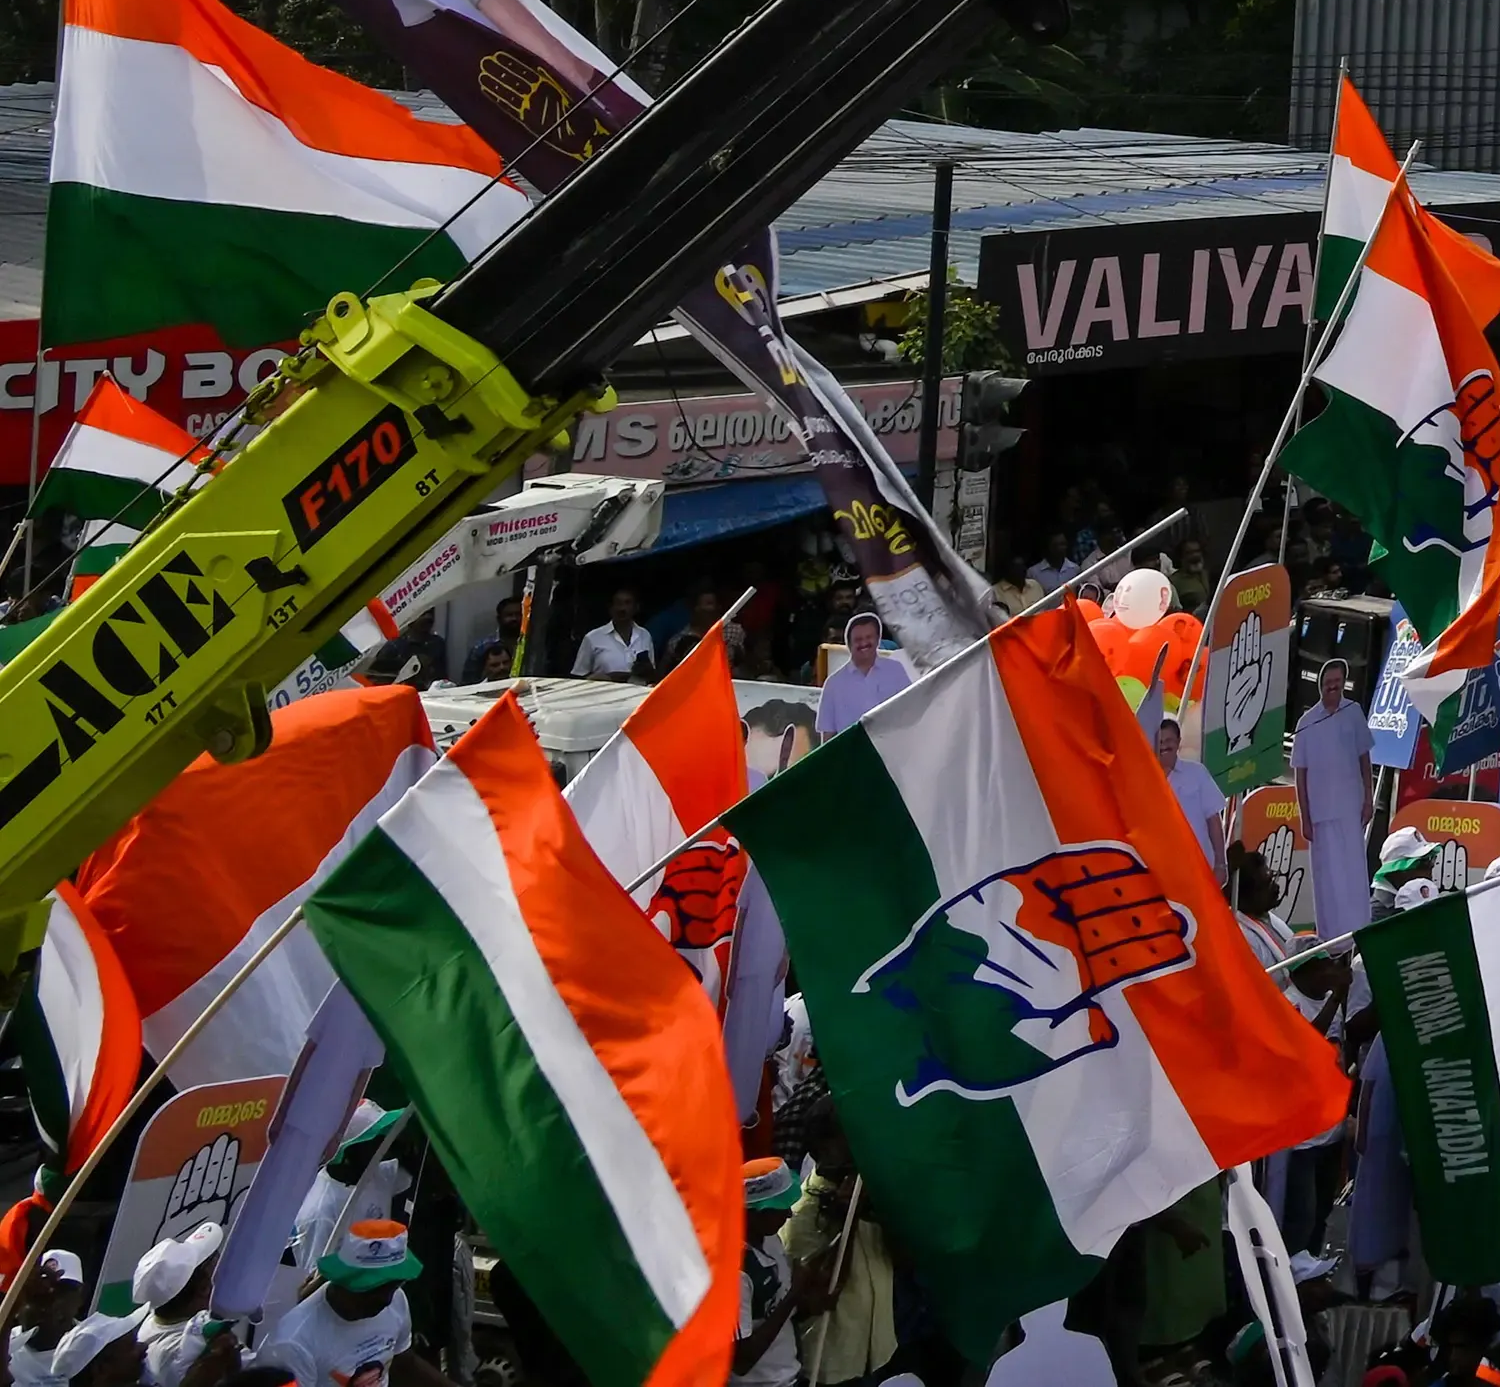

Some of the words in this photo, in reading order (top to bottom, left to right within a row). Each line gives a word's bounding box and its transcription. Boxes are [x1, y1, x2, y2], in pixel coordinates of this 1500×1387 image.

[1026, 345, 1104, 366] പേരൂർക്കട
[0, 348, 166, 417] CITY
[299, 421, 400, 530] F170
[415, 468, 442, 497] 8T
[488, 511, 559, 536] Whiteness
[385, 542, 459, 610] Whiteness
[266, 595, 301, 632] 13T
[38, 550, 236, 763] ACE
[144, 690, 179, 727] 17T
[1427, 814, 1481, 836] നമ്മുടെ
[1397, 950, 1467, 1046] NATIONAL
[196, 1098, 268, 1128] നമ്മുടെ
